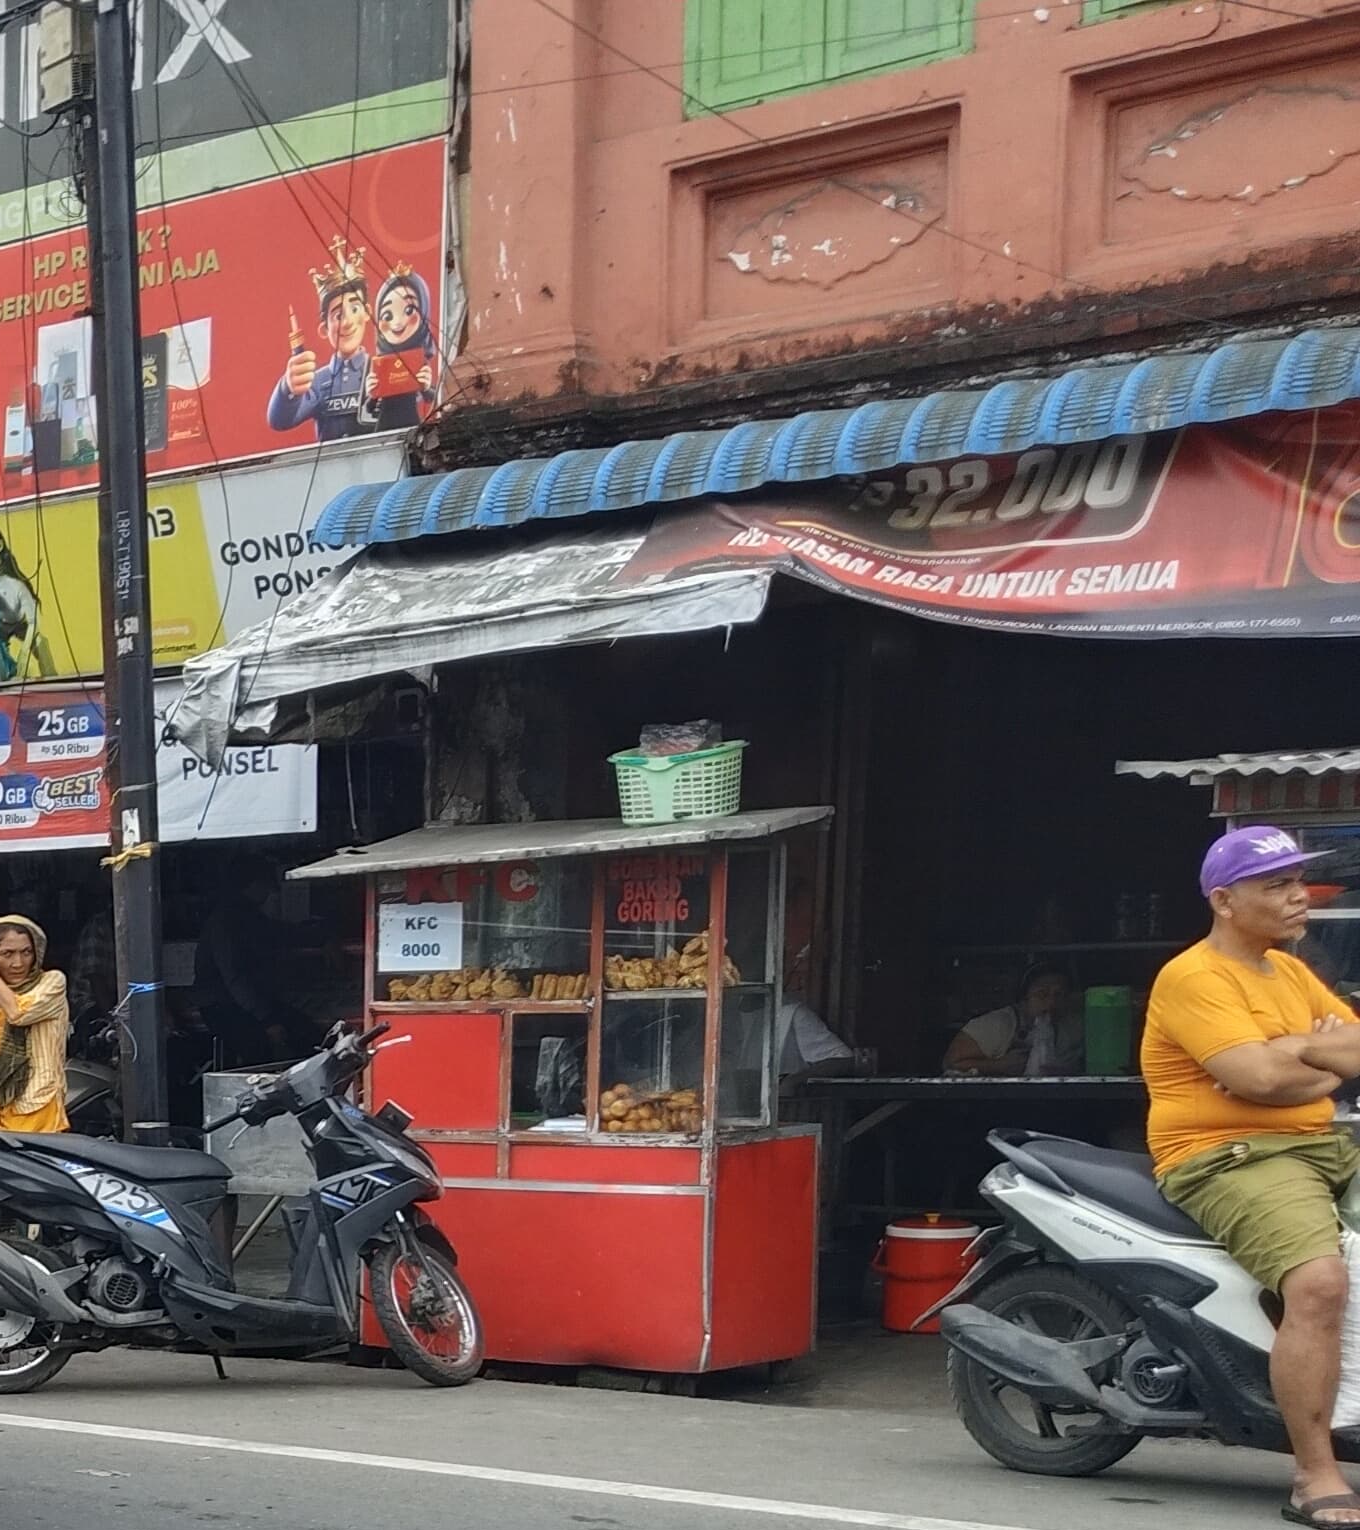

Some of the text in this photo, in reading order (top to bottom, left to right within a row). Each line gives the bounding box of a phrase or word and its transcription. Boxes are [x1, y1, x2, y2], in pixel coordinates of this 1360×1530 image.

[34, 251, 65, 280] HP
[172, 249, 220, 286] AJA
[873, 560, 1180, 598] RASA UNTUK SEMUA
[1155, 620, 1213, 632] MEROKOK
[37, 710, 90, 736] 25 GB
[52, 744, 65, 755] 50
[67, 743, 89, 754] Ribu
[49, 773, 100, 796] BEST
[5, 787, 26, 804] GB
[5, 814, 26, 825] Ribu
[617, 899, 689, 923] GORENG
[405, 916, 438, 931] KFC
[401, 943, 441, 956] 8000
